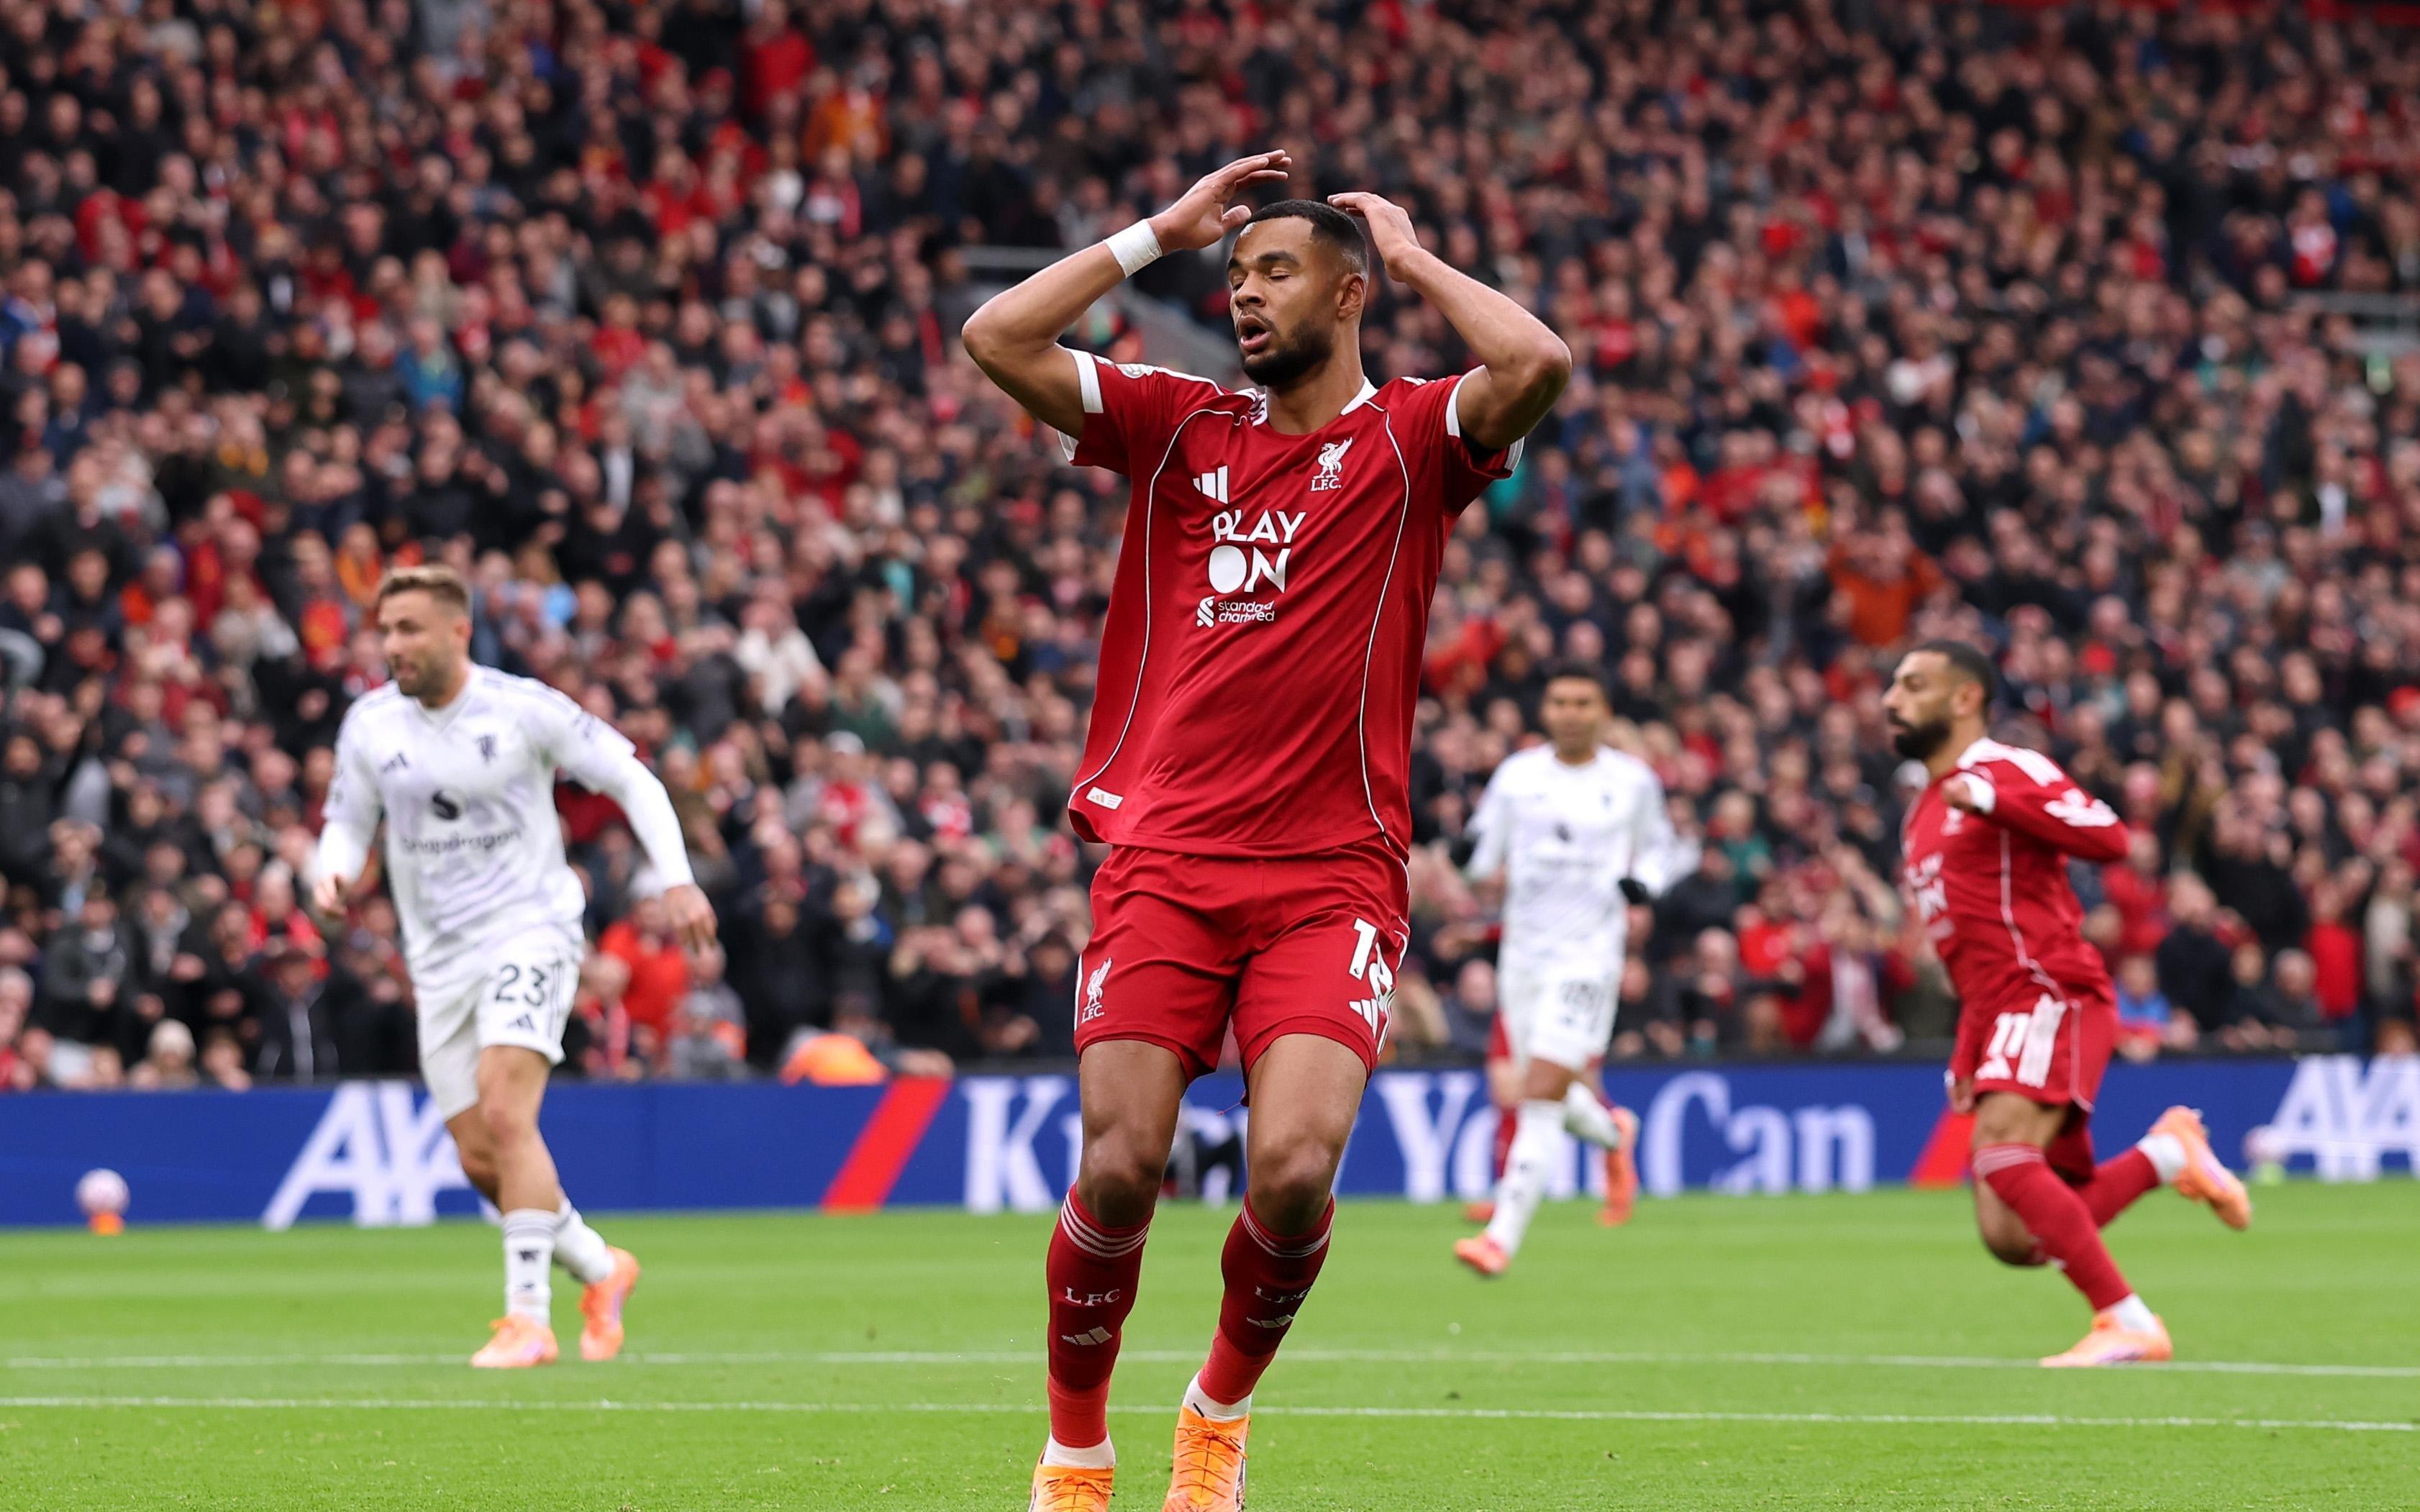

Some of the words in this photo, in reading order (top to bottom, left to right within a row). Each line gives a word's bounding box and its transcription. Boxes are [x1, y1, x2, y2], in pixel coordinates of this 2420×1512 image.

[1213, 509, 1306, 543] PLAY
[1209, 545, 1291, 594] ON
[1218, 600, 1275, 613] standad
[400, 829, 522, 856] Snapdragon
[494, 962, 547, 1008] 23
[1985, 1012, 2032, 1059] 11
[1642, 1070, 1877, 1198] Can
[1065, 1286, 1120, 1306] LFC
